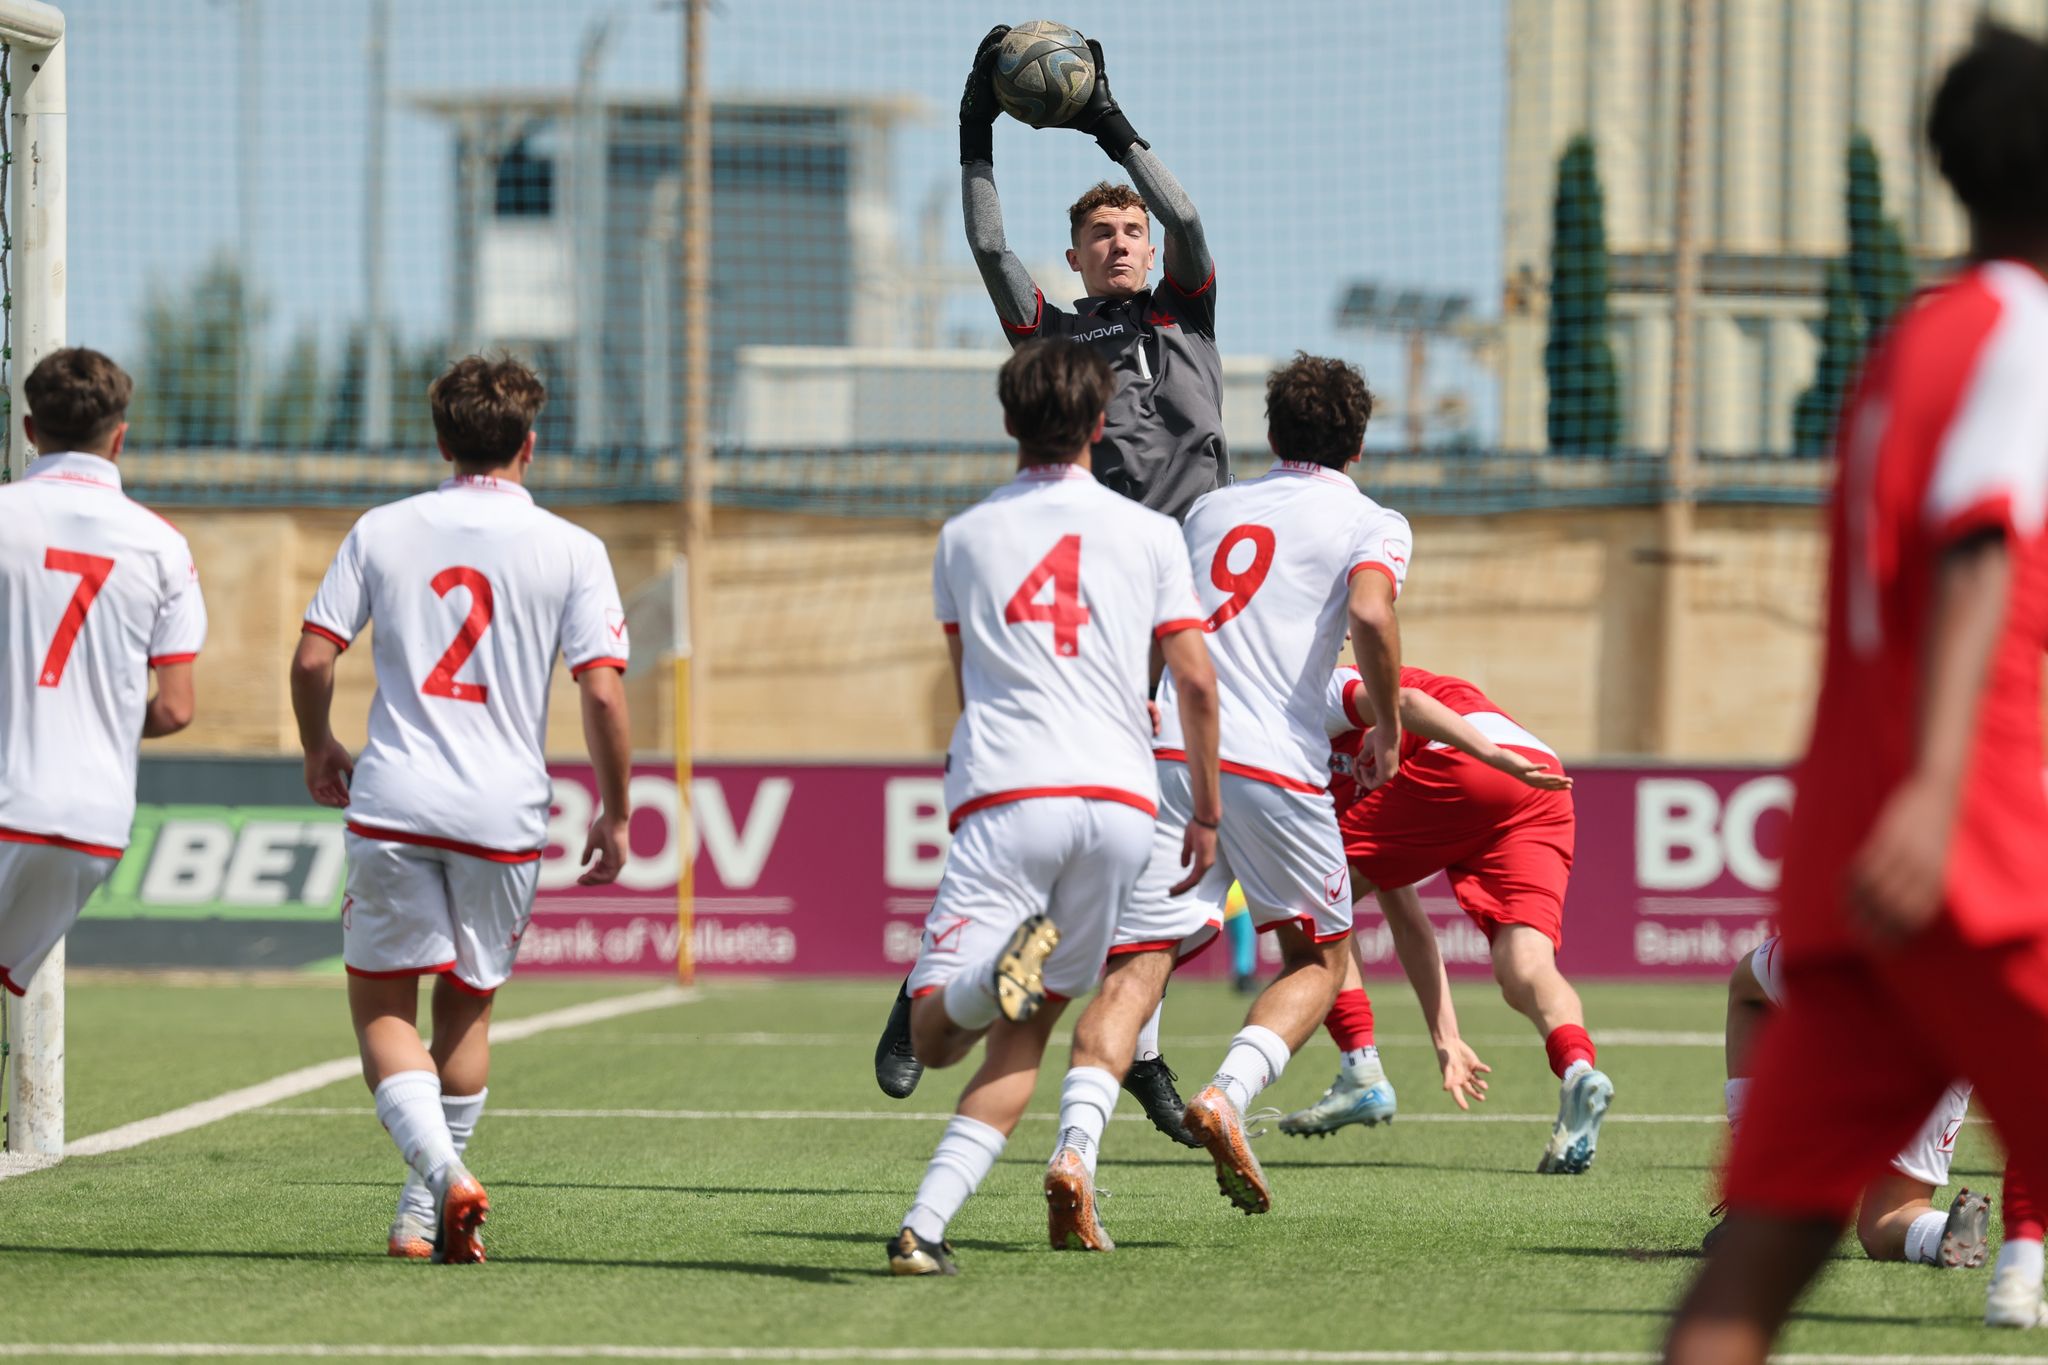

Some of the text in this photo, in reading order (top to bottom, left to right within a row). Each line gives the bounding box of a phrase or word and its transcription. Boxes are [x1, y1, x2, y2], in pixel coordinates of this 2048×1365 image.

[37, 547, 116, 689] 7
[420, 565, 494, 704] 2
[1004, 534, 1090, 657] 4
[1201, 524, 1276, 633] 9
[535, 775, 795, 890] BOV
[1635, 775, 1798, 892] BO
[1635, 918, 1729, 965] Bank
